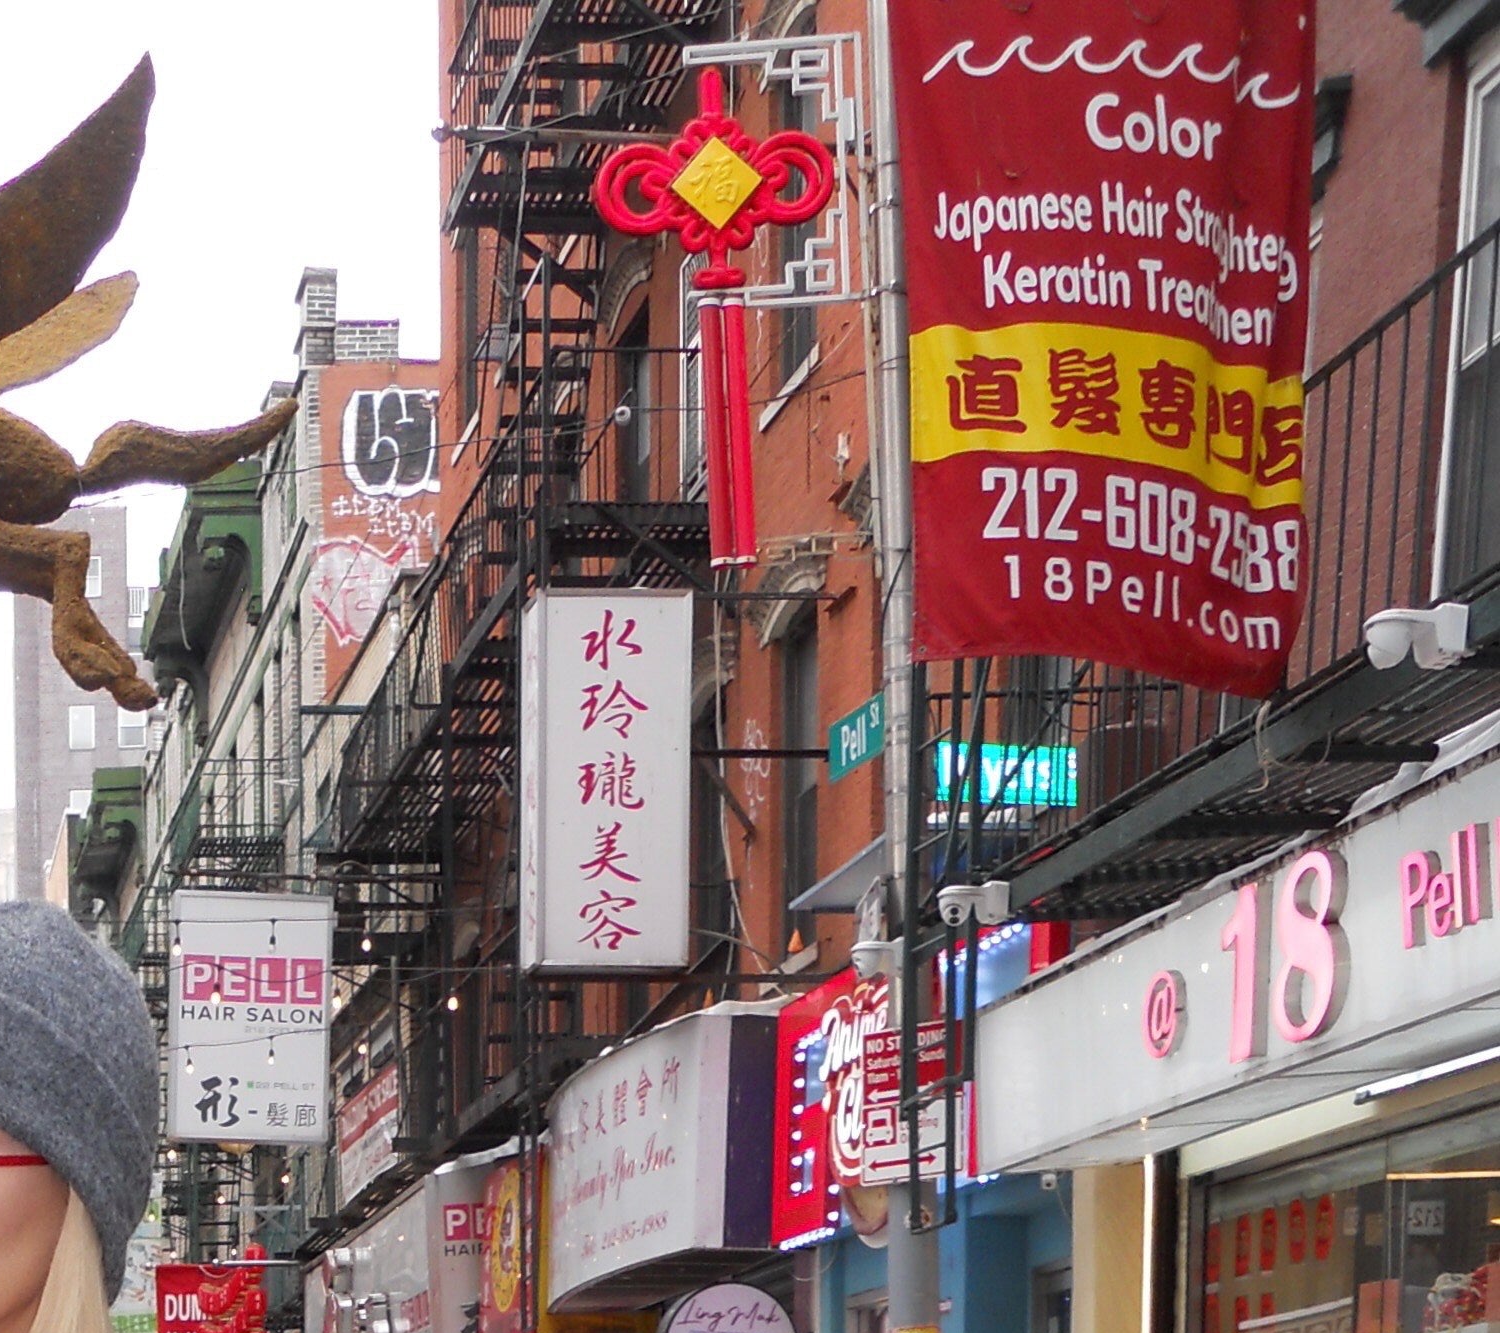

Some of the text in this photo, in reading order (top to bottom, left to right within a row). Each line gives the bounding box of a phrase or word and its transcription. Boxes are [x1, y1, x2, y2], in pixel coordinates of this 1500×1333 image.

[1085, 92, 1222, 161] Color
[688, 155, 740, 208] 福
[934, 190, 1092, 252] Japanese
[1100, 180, 1169, 239] Hair
[983, 250, 1131, 309] Keratin
[981, 467, 1300, 593] 212-608-2588
[840, 701, 880, 767] Pell St
[578, 609, 649, 951] 水玲瓏美容
[1142, 823, 1480, 1064] @ 18 Pell
[184, 960, 319, 999] PELL
[181, 1004, 323, 1024] HAIR SALON
[866, 1028, 947, 1054] NO STDING
[677, 1300, 725, 1332] Ling
